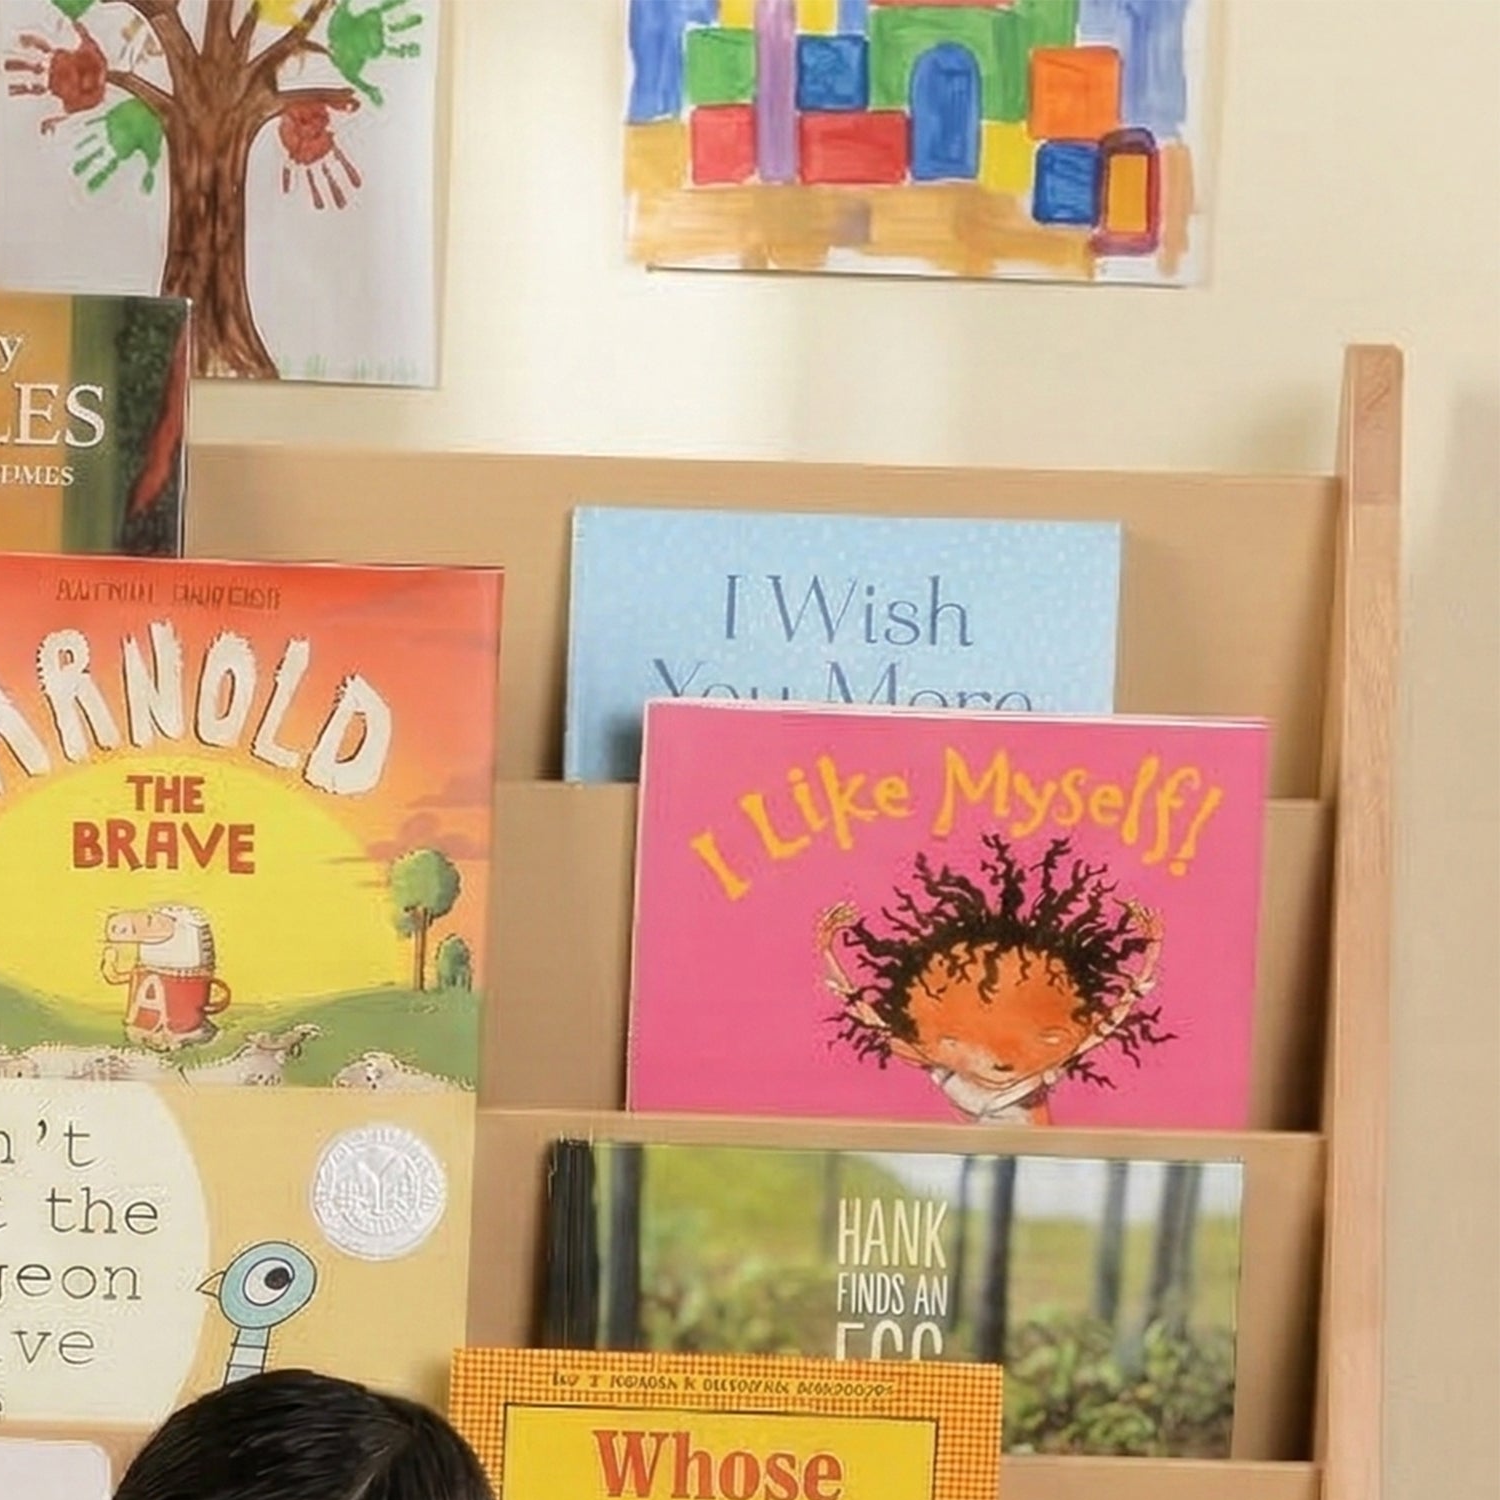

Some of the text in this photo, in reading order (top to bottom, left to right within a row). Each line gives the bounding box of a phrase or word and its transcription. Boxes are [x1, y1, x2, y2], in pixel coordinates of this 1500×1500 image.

[723, 574, 975, 647] I Wish
[126, 775, 206, 815] THE
[72, 820, 256, 875] BRAVE
[691, 747, 1224, 901] I Like Myself!
[45, 1187, 160, 1235] the
[838, 1197, 949, 1269] HANK
[837, 1272, 949, 1317] FINDS AN
